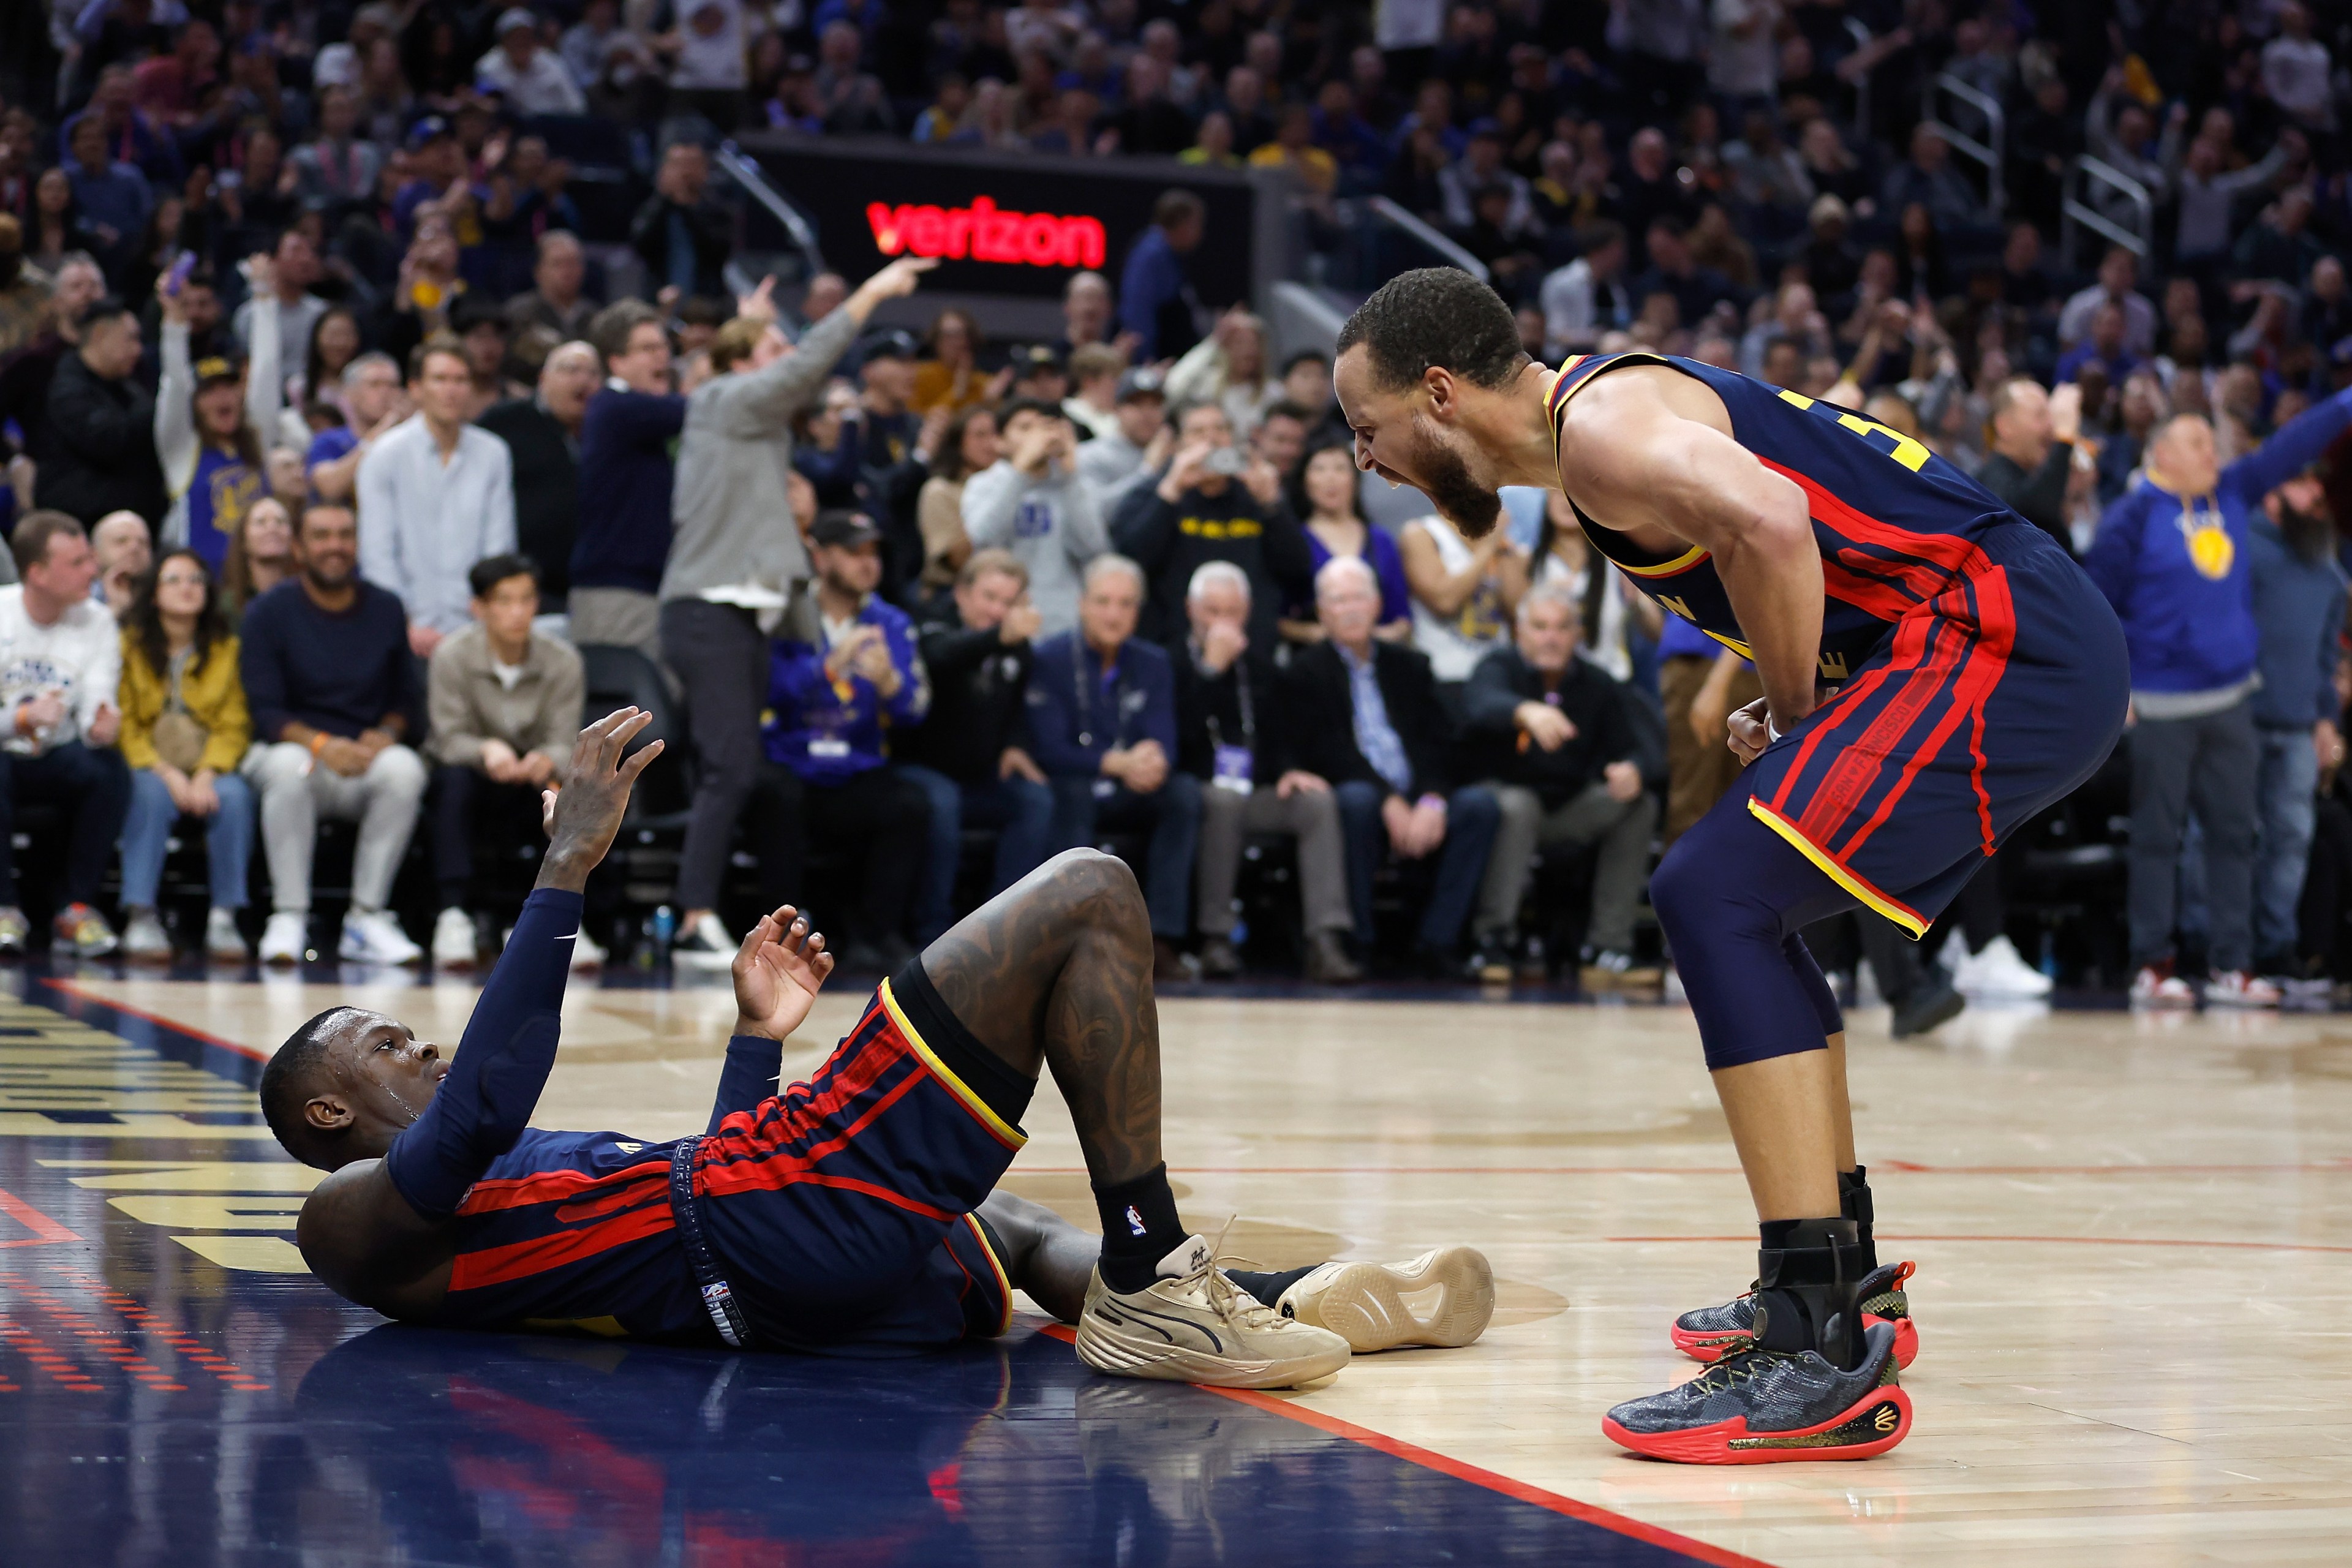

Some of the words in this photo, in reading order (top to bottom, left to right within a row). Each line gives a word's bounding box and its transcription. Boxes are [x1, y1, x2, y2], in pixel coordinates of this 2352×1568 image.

[866, 195, 1106, 270] verizon
[1831, 775, 1855, 804] SAN
[1853, 705, 1910, 769] FRANCISCO
